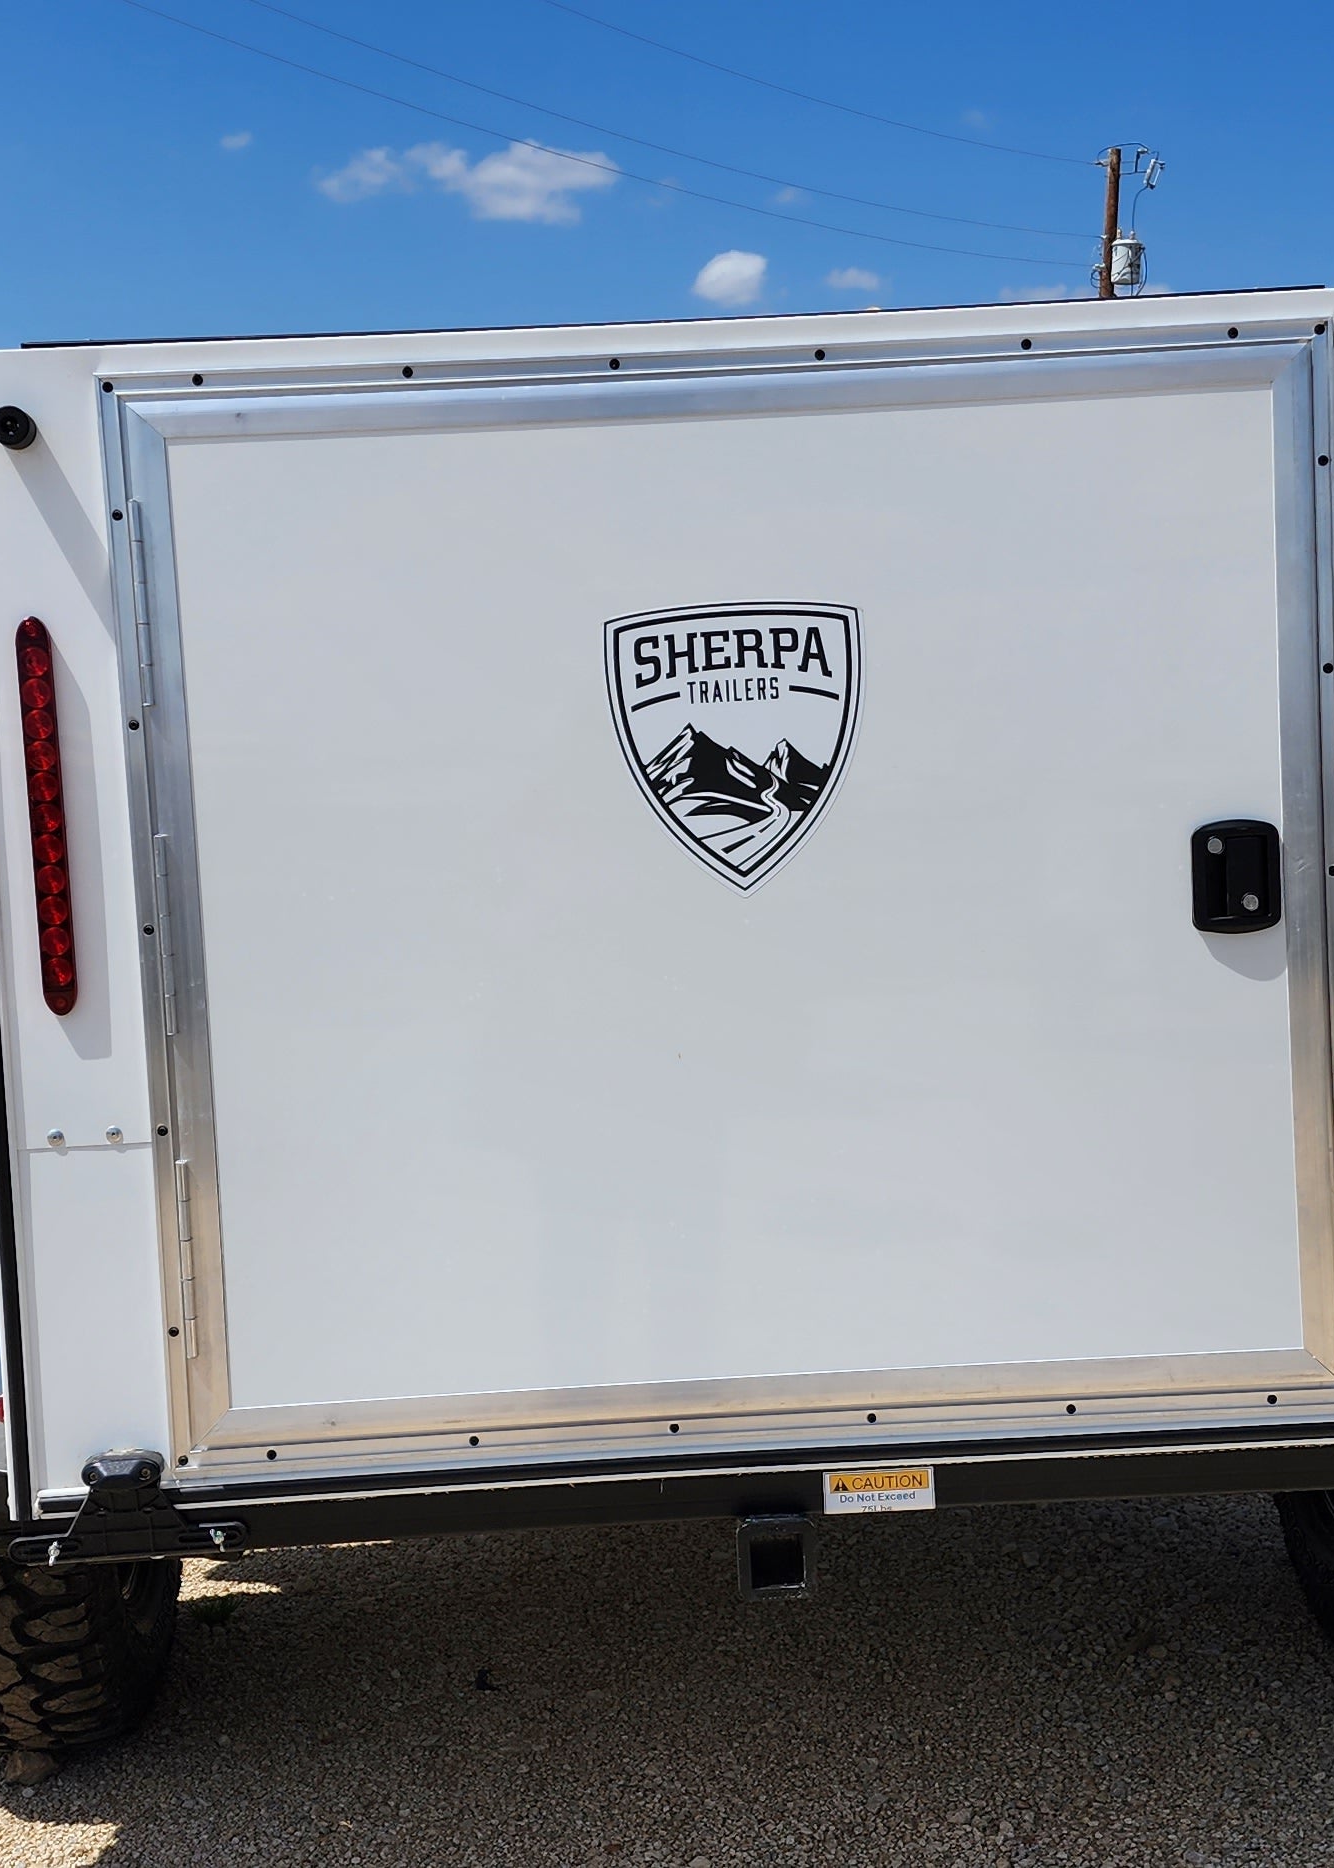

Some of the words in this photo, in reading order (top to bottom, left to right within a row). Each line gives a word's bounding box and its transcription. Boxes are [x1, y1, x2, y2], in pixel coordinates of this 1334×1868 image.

[632, 625, 833, 689] SHERPA
[686, 676, 780, 705] TRAILERS
[851, 1473, 923, 1490] CAUTION
[839, 1494, 854, 1503] Do
[856, 1492, 875, 1503] Not
[877, 1490, 916, 1502] Exceed
